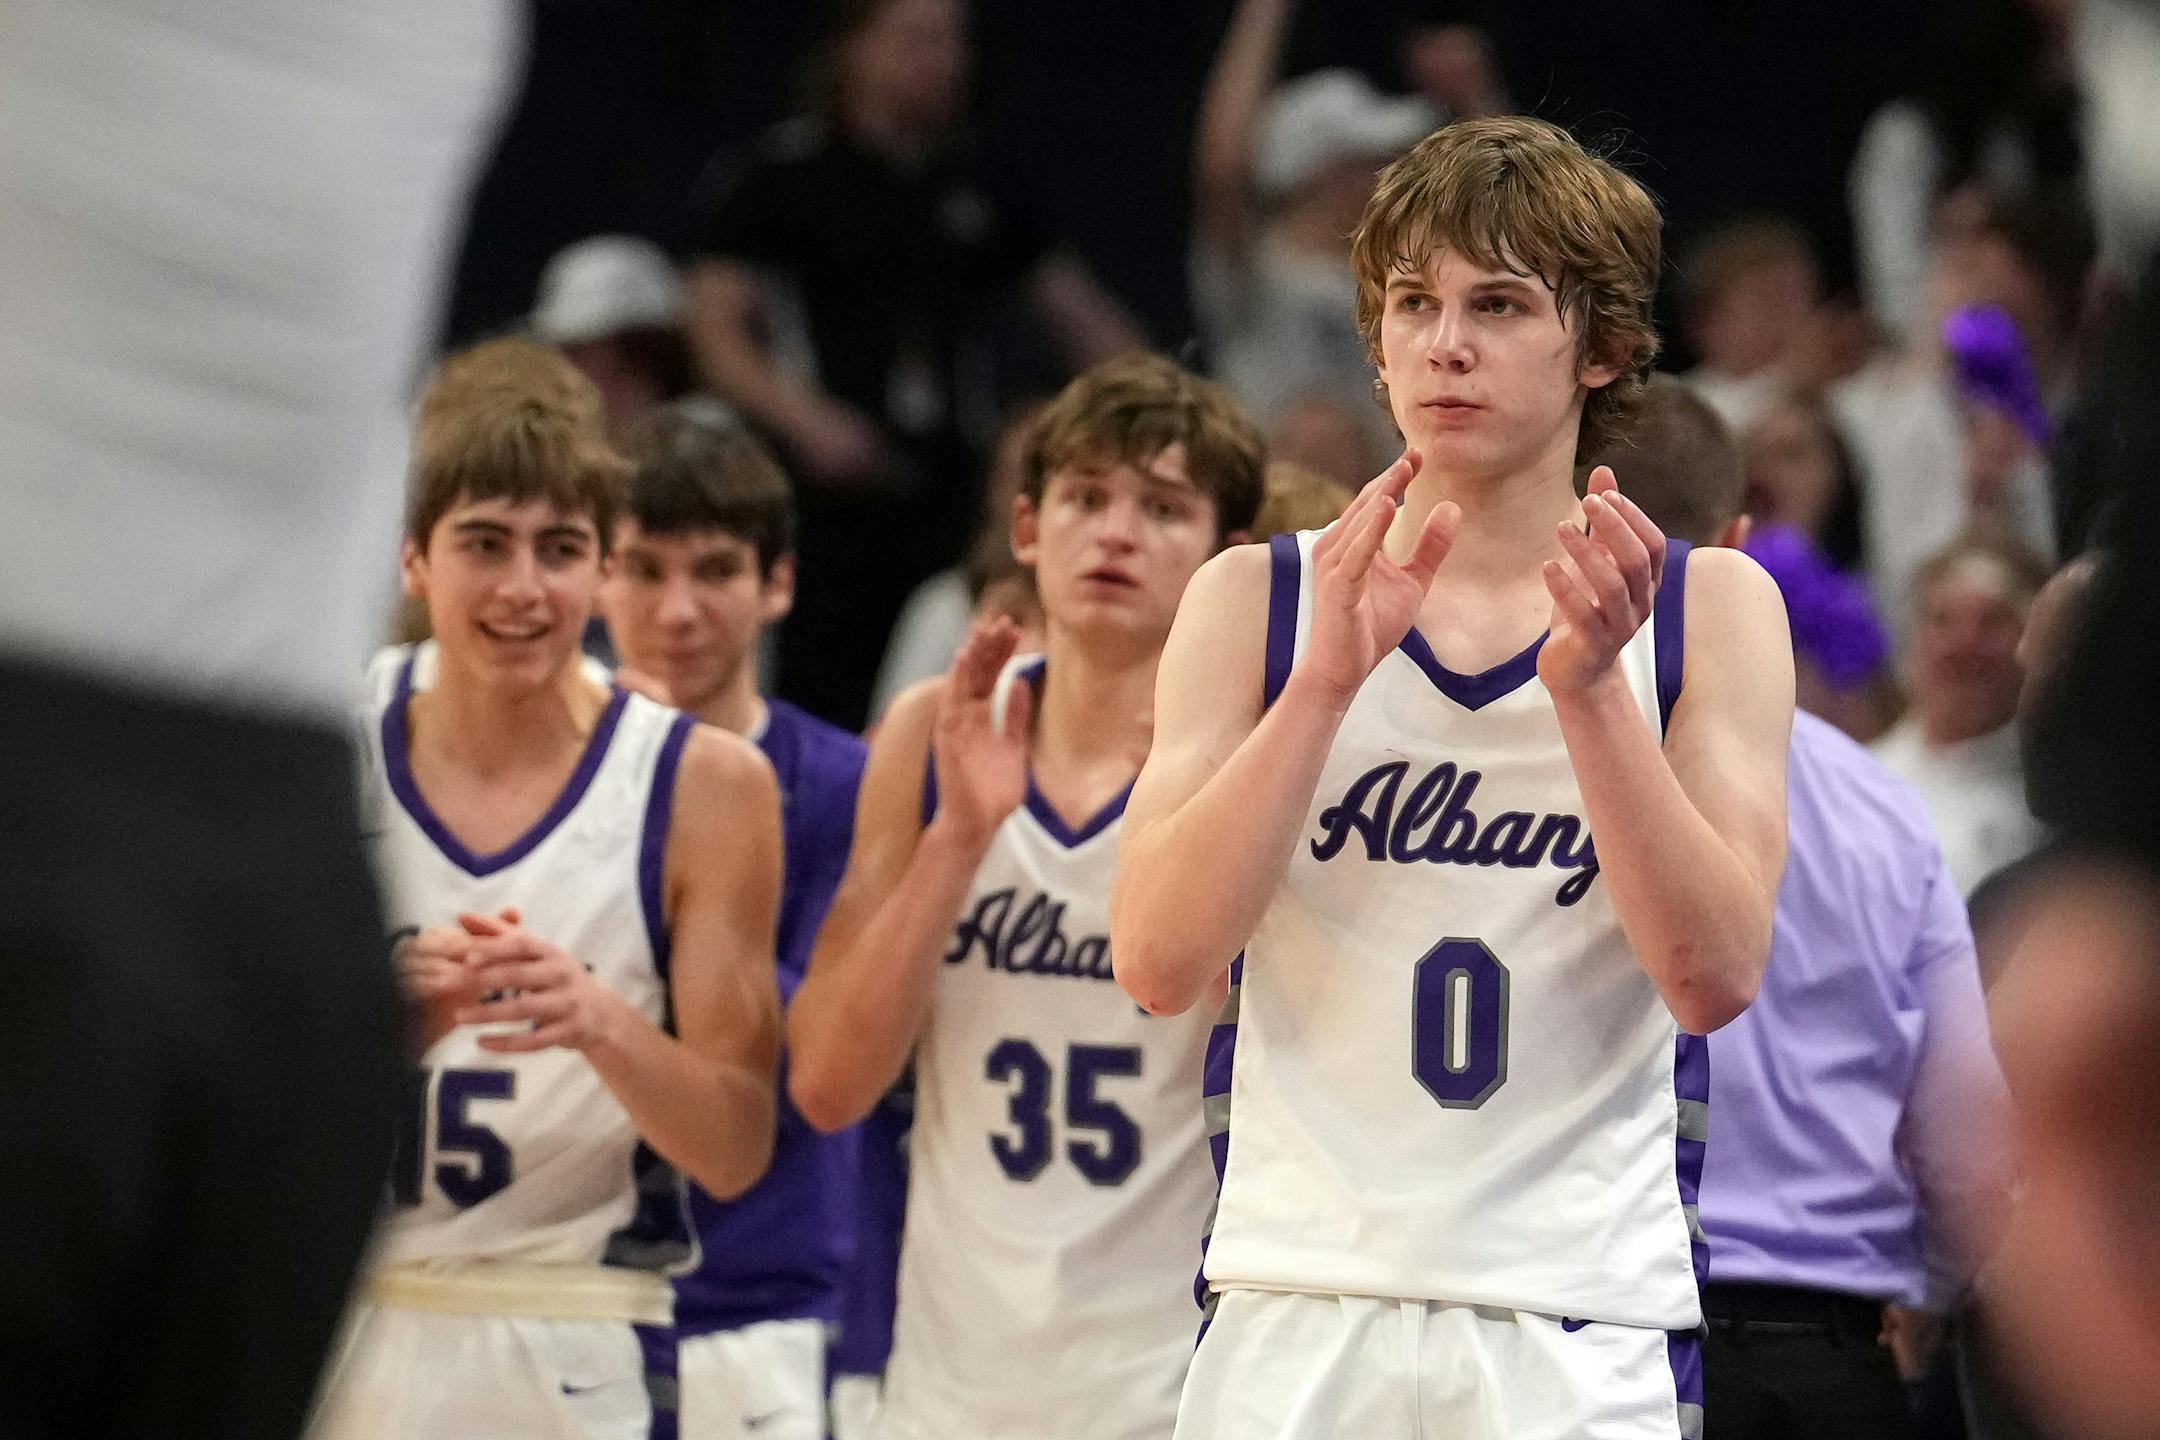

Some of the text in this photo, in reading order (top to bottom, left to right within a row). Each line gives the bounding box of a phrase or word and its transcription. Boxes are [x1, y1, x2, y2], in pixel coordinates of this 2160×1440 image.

[944, 887, 1117, 982] Alba
[1412, 936, 1510, 1110] 0
[986, 1038, 1143, 1186] 35
